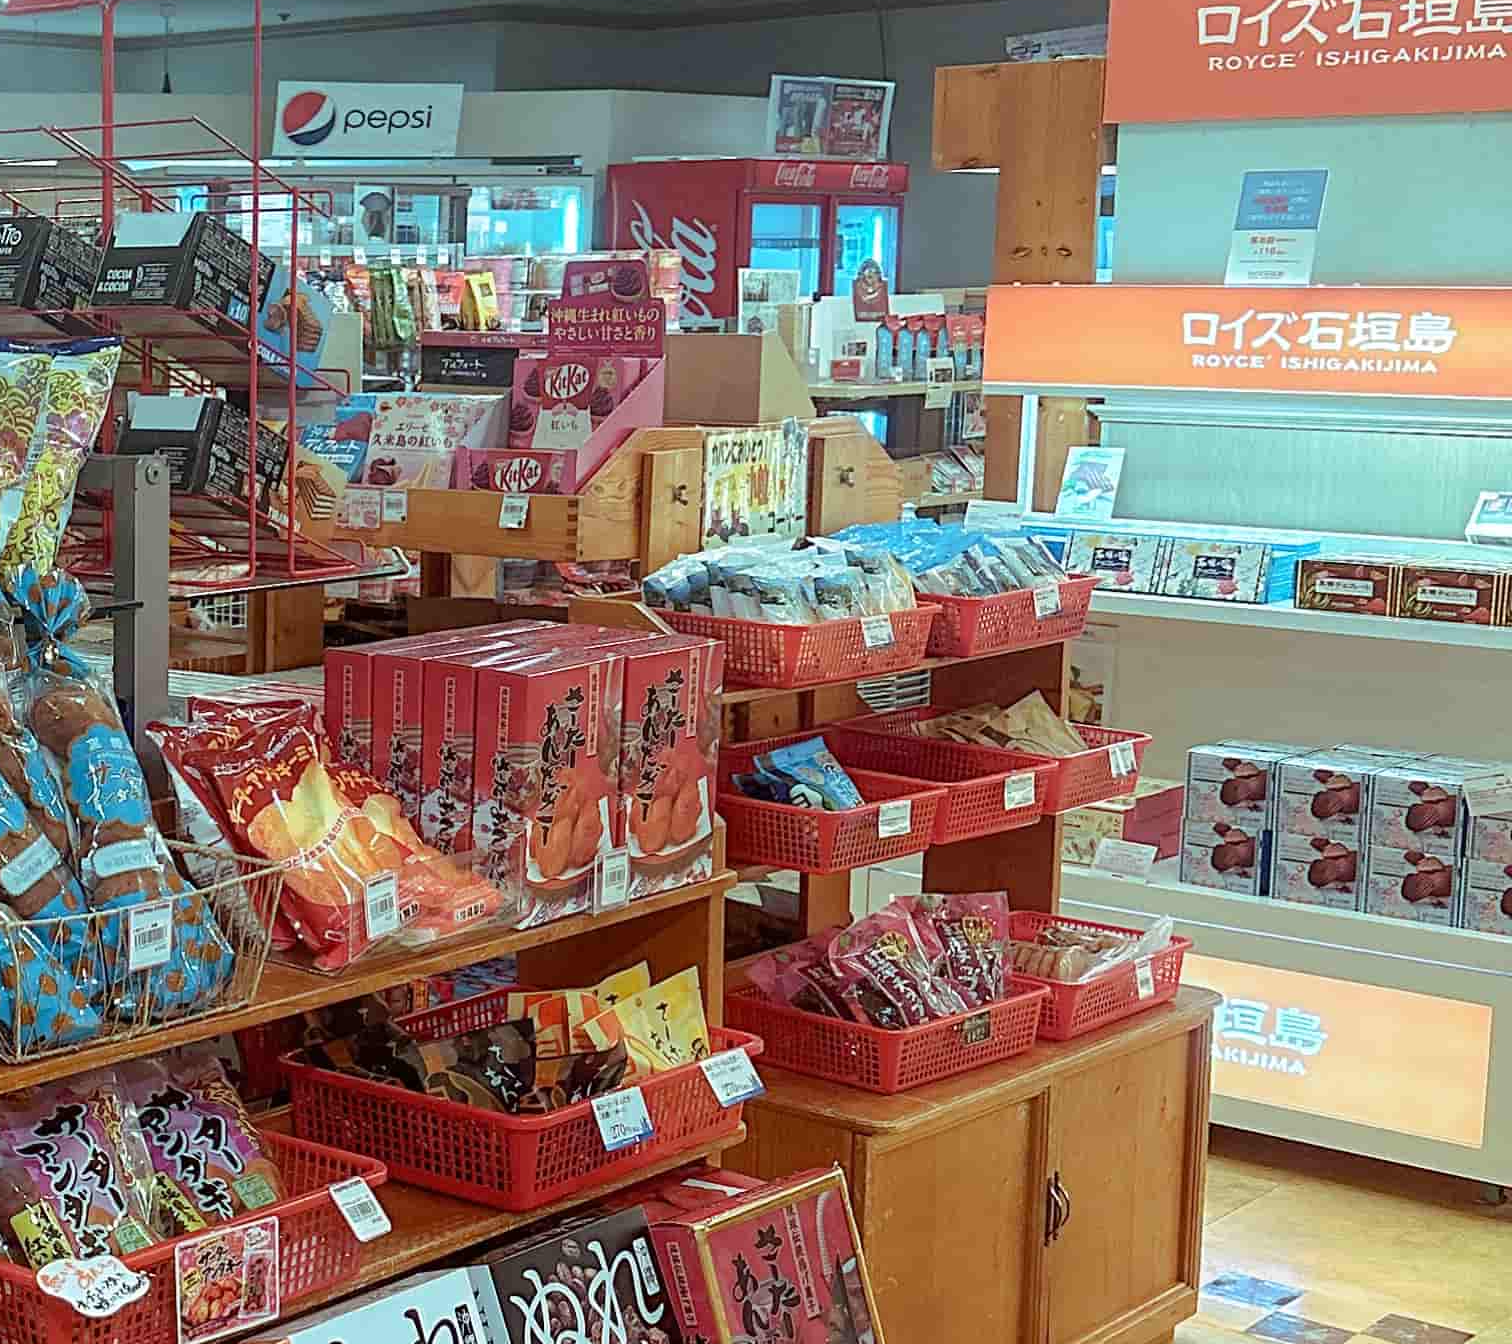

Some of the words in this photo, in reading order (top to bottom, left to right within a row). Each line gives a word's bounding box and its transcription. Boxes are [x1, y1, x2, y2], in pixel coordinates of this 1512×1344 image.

[1315, 43, 1507, 67] ISHIGAKIJIMA
[343, 105, 433, 134] pepsi
[553, 324, 657, 341] やさしい甘さと香り
[1182, 309, 1458, 354] ロイズ石垣島
[1280, 355, 1438, 375] ISHIGAKIJIMA
[546, 364, 591, 398] KitKat
[500, 459, 540, 494] KitKat
